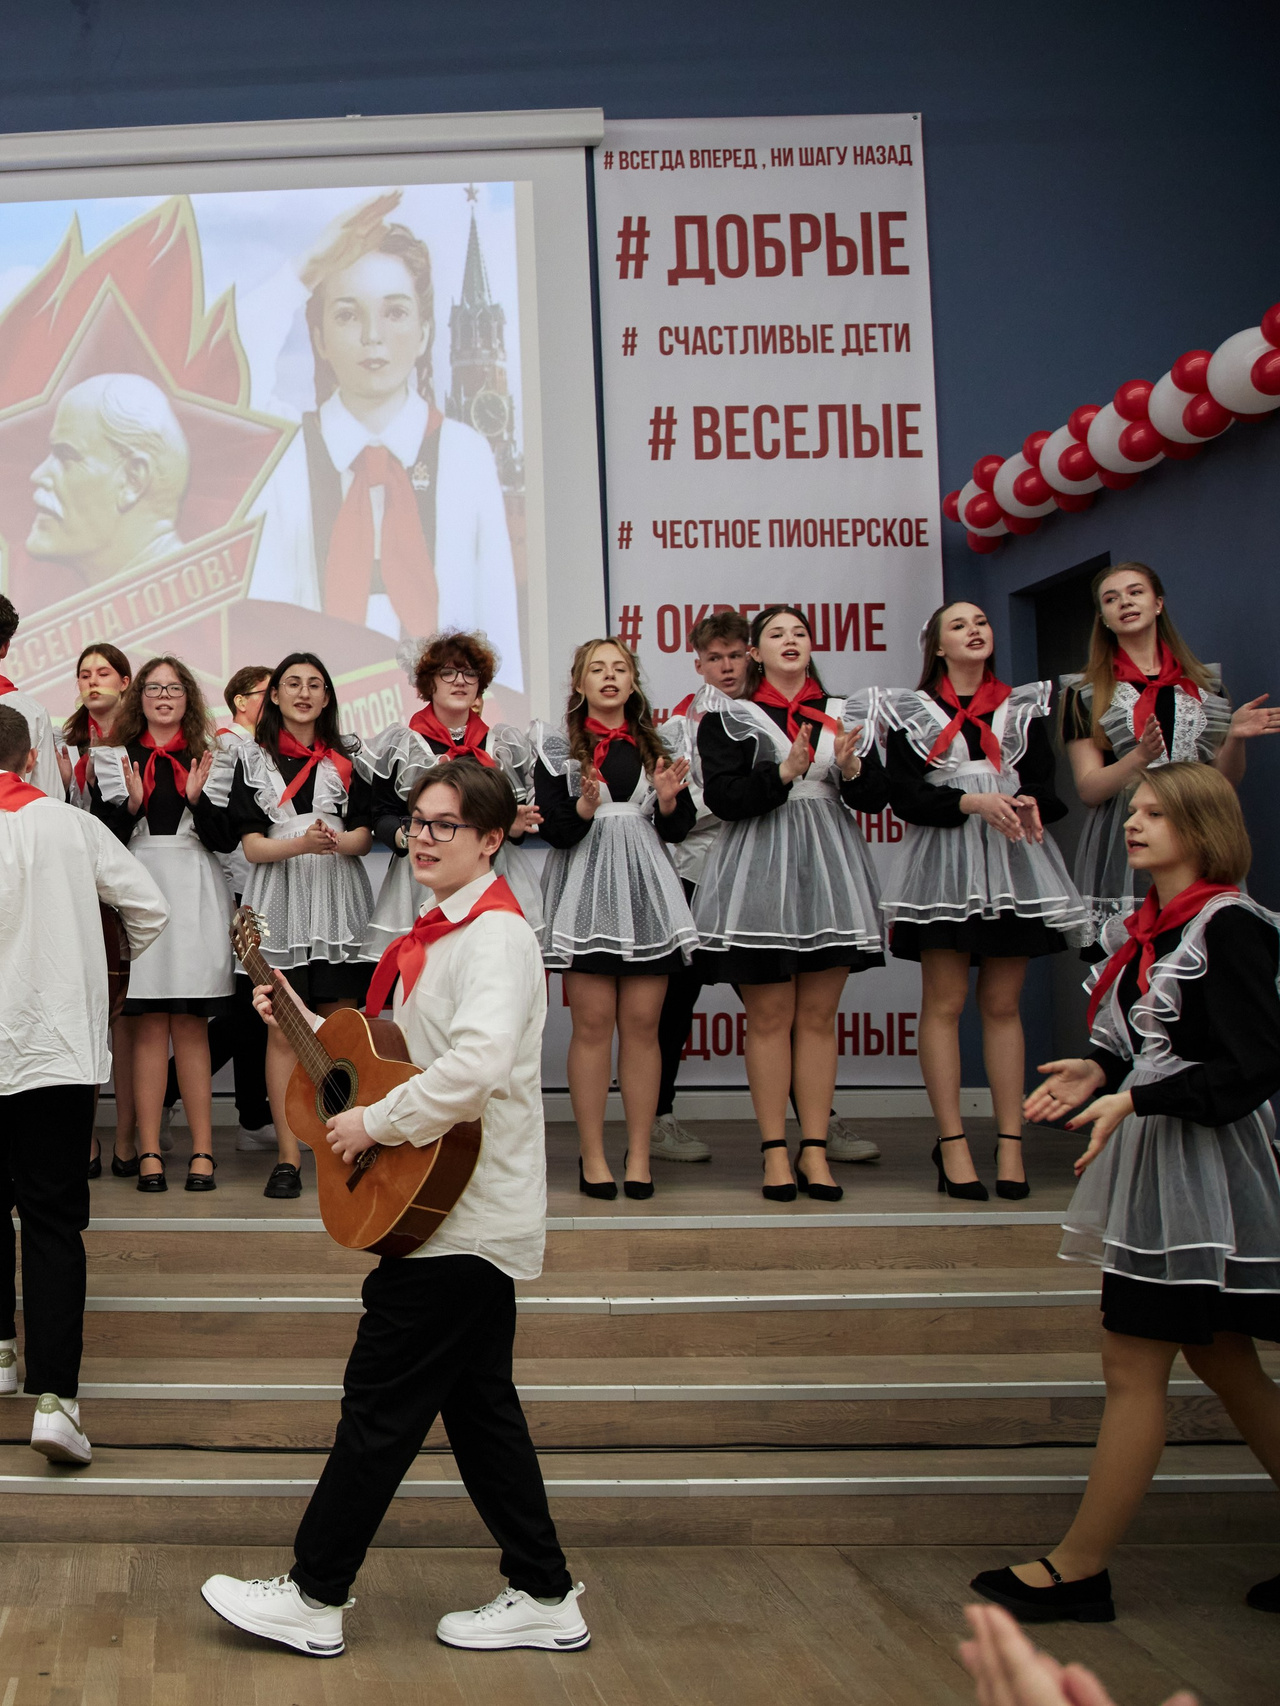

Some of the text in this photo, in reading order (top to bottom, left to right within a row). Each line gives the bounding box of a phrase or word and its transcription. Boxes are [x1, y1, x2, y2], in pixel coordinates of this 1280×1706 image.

[619, 150, 685, 171] ВСЕГДА
[690, 148, 757, 170] ВПЕРЕД
[771, 148, 794, 167] НИ
[799, 146, 848, 167] ШАГУ
[853, 144, 913, 167] НАЗАД
[616, 210, 910, 286] # ДОБРЫЕ
[622, 323, 911, 356] # СЧАСТЛИВЫЕ ДЕТИ
[648, 403, 923, 461] # ВЕСЕЛЫЕ
[618, 517, 929, 550] # ЧЕСТНОЕ ПИОНЕРСКОЕ
[6, 549, 240, 680] ВСЕГДА ГОТОВ!
[657, 602, 887, 653] ОКШИЕ
[340, 683, 409, 739] ОТОВ!
